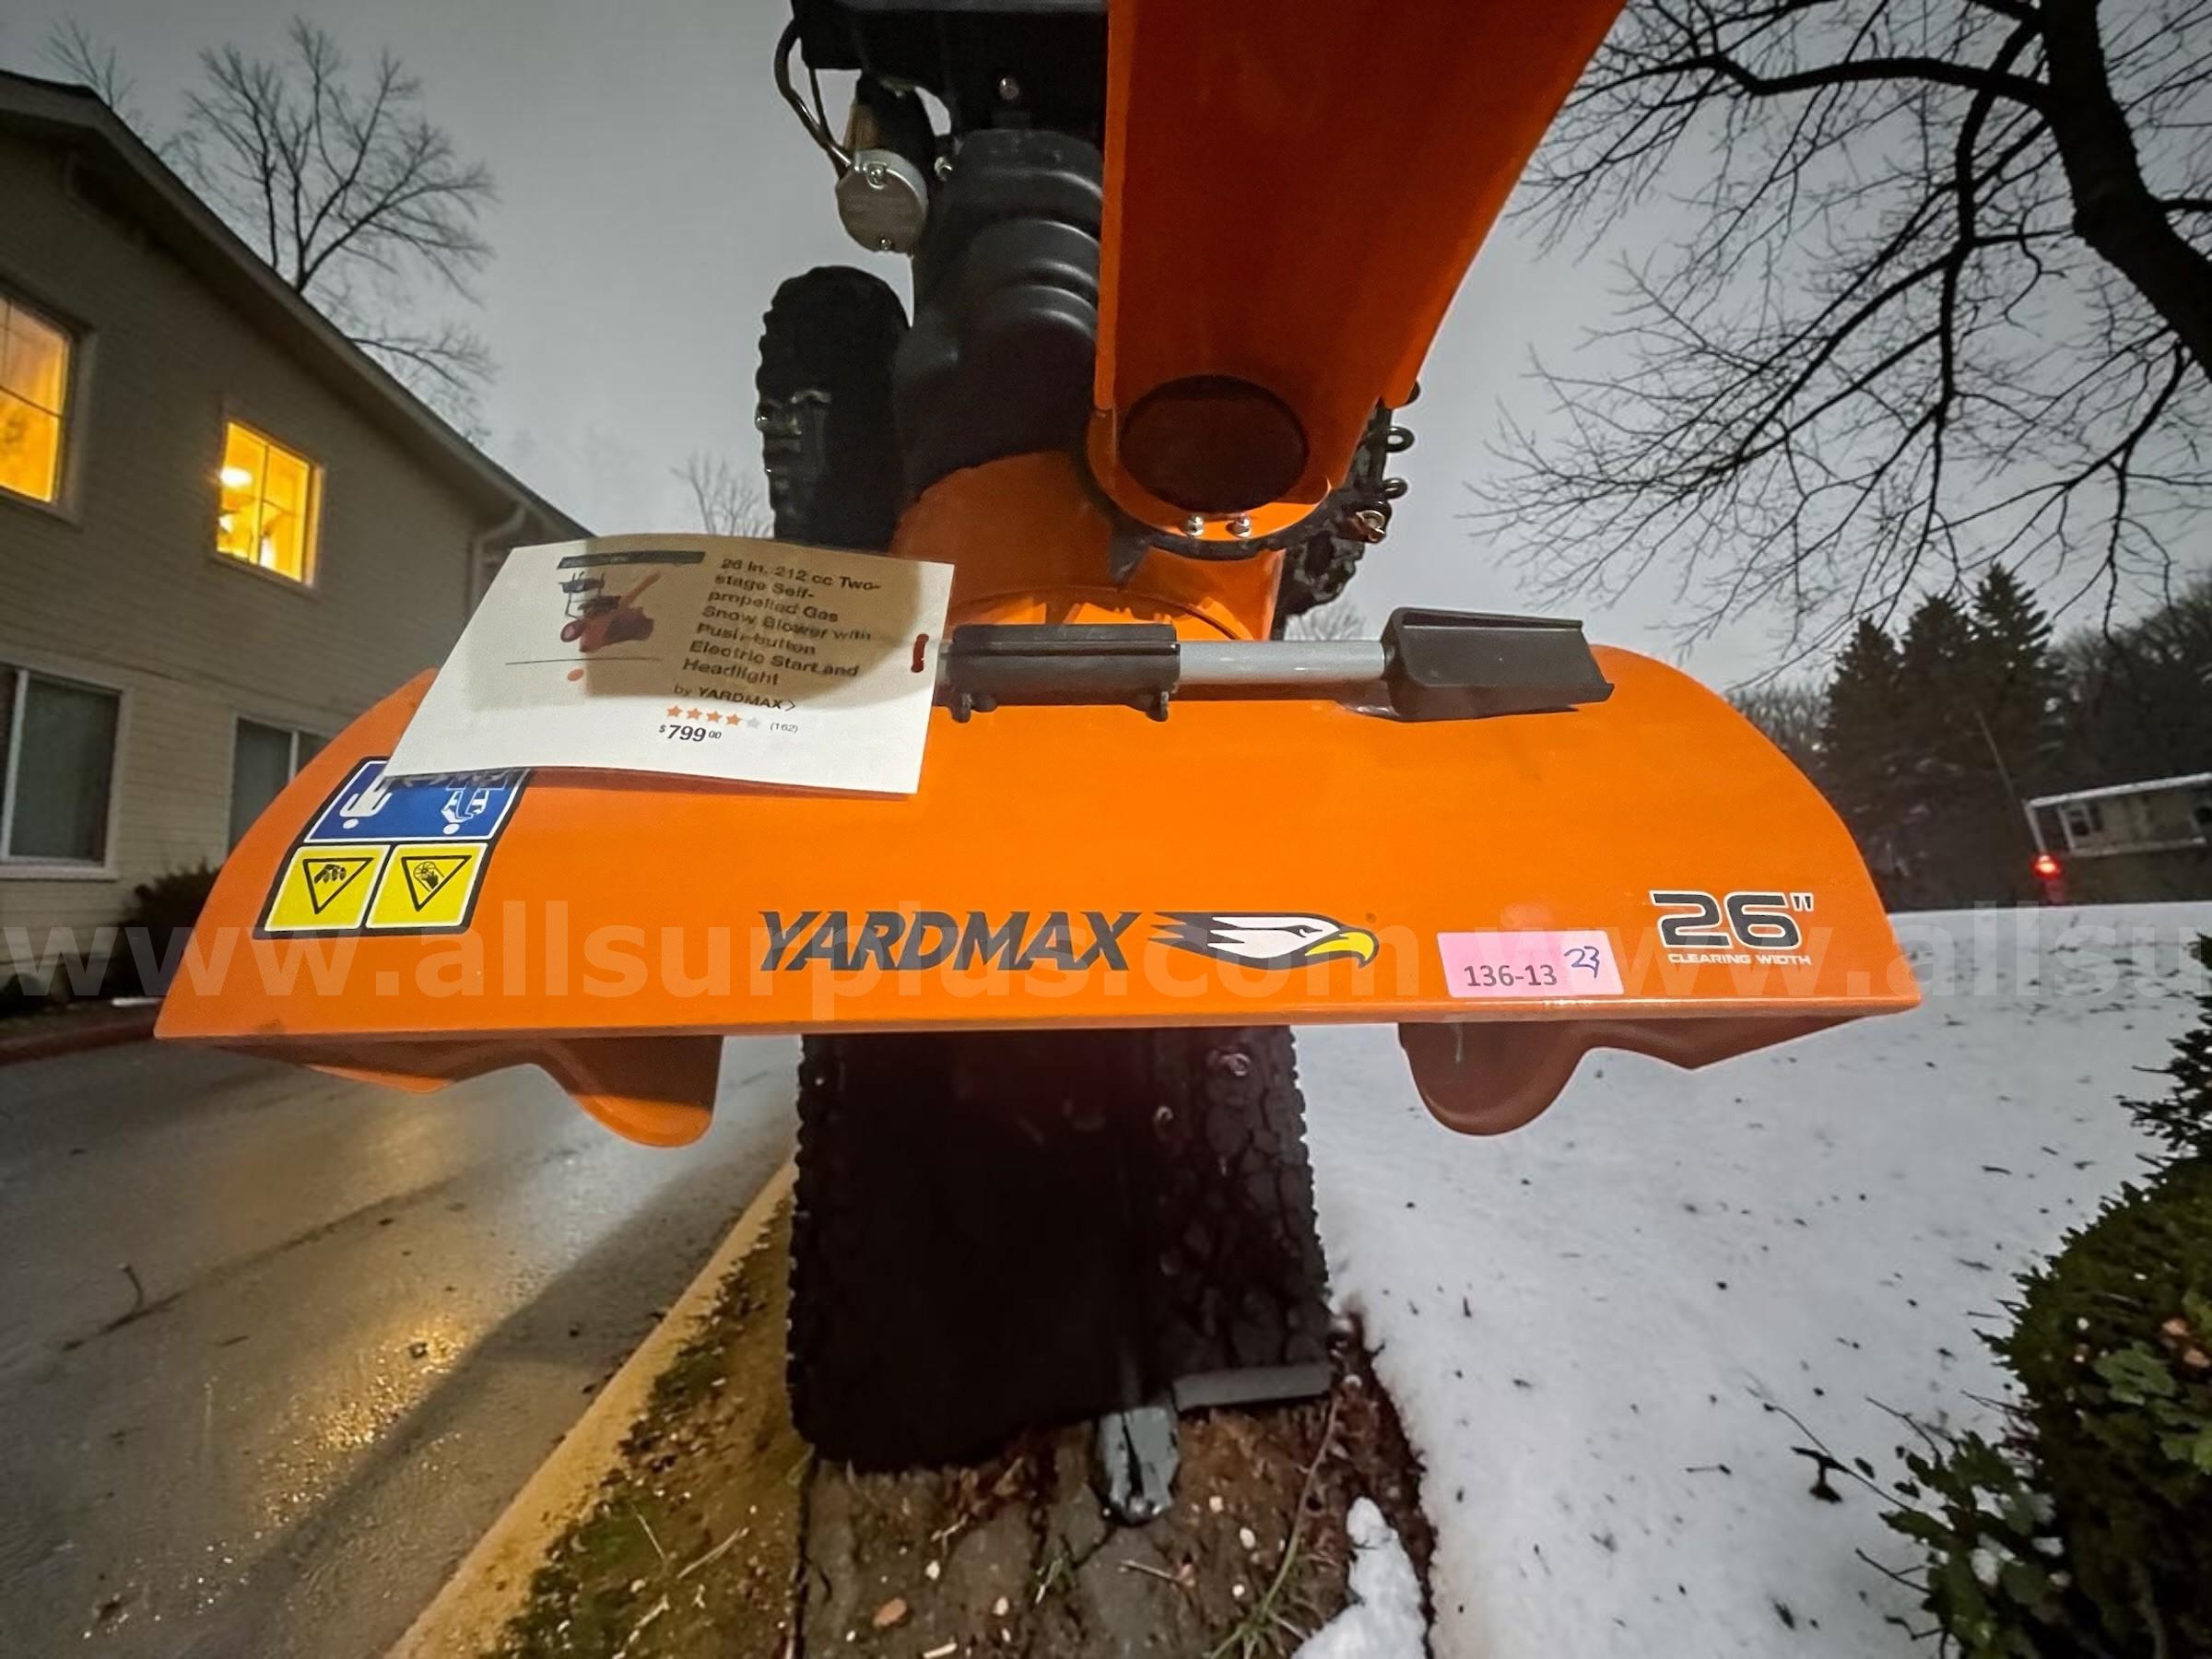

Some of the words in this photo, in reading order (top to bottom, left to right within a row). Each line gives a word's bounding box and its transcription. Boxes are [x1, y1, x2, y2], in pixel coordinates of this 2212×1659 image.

[715, 573, 766, 592] stage
[772, 582, 815, 599] Self-
[775, 566, 807, 582] 212
[812, 574, 832, 586] cc
[840, 575, 881, 591] Two-
[708, 591, 798, 616] propelled
[803, 606, 839, 622] Gas
[701, 606, 758, 626] Snow
[763, 615, 829, 639] Blower
[831, 628, 871, 641] with
[682, 658, 779, 686] Headlight
[689, 641, 765, 664] Electric
[771, 655, 818, 673] Start
[822, 664, 859, 677] and
[674, 684, 691, 696] by
[770, 721, 798, 734] (162)
[1649, 890, 1814, 950] 26"
[759, 912, 1142, 971] YARDMAX
[1667, 953, 1751, 965] CLEARING
[1755, 954, 1812, 965] WIDTH
[1464, 964, 1558, 987] 136-13
